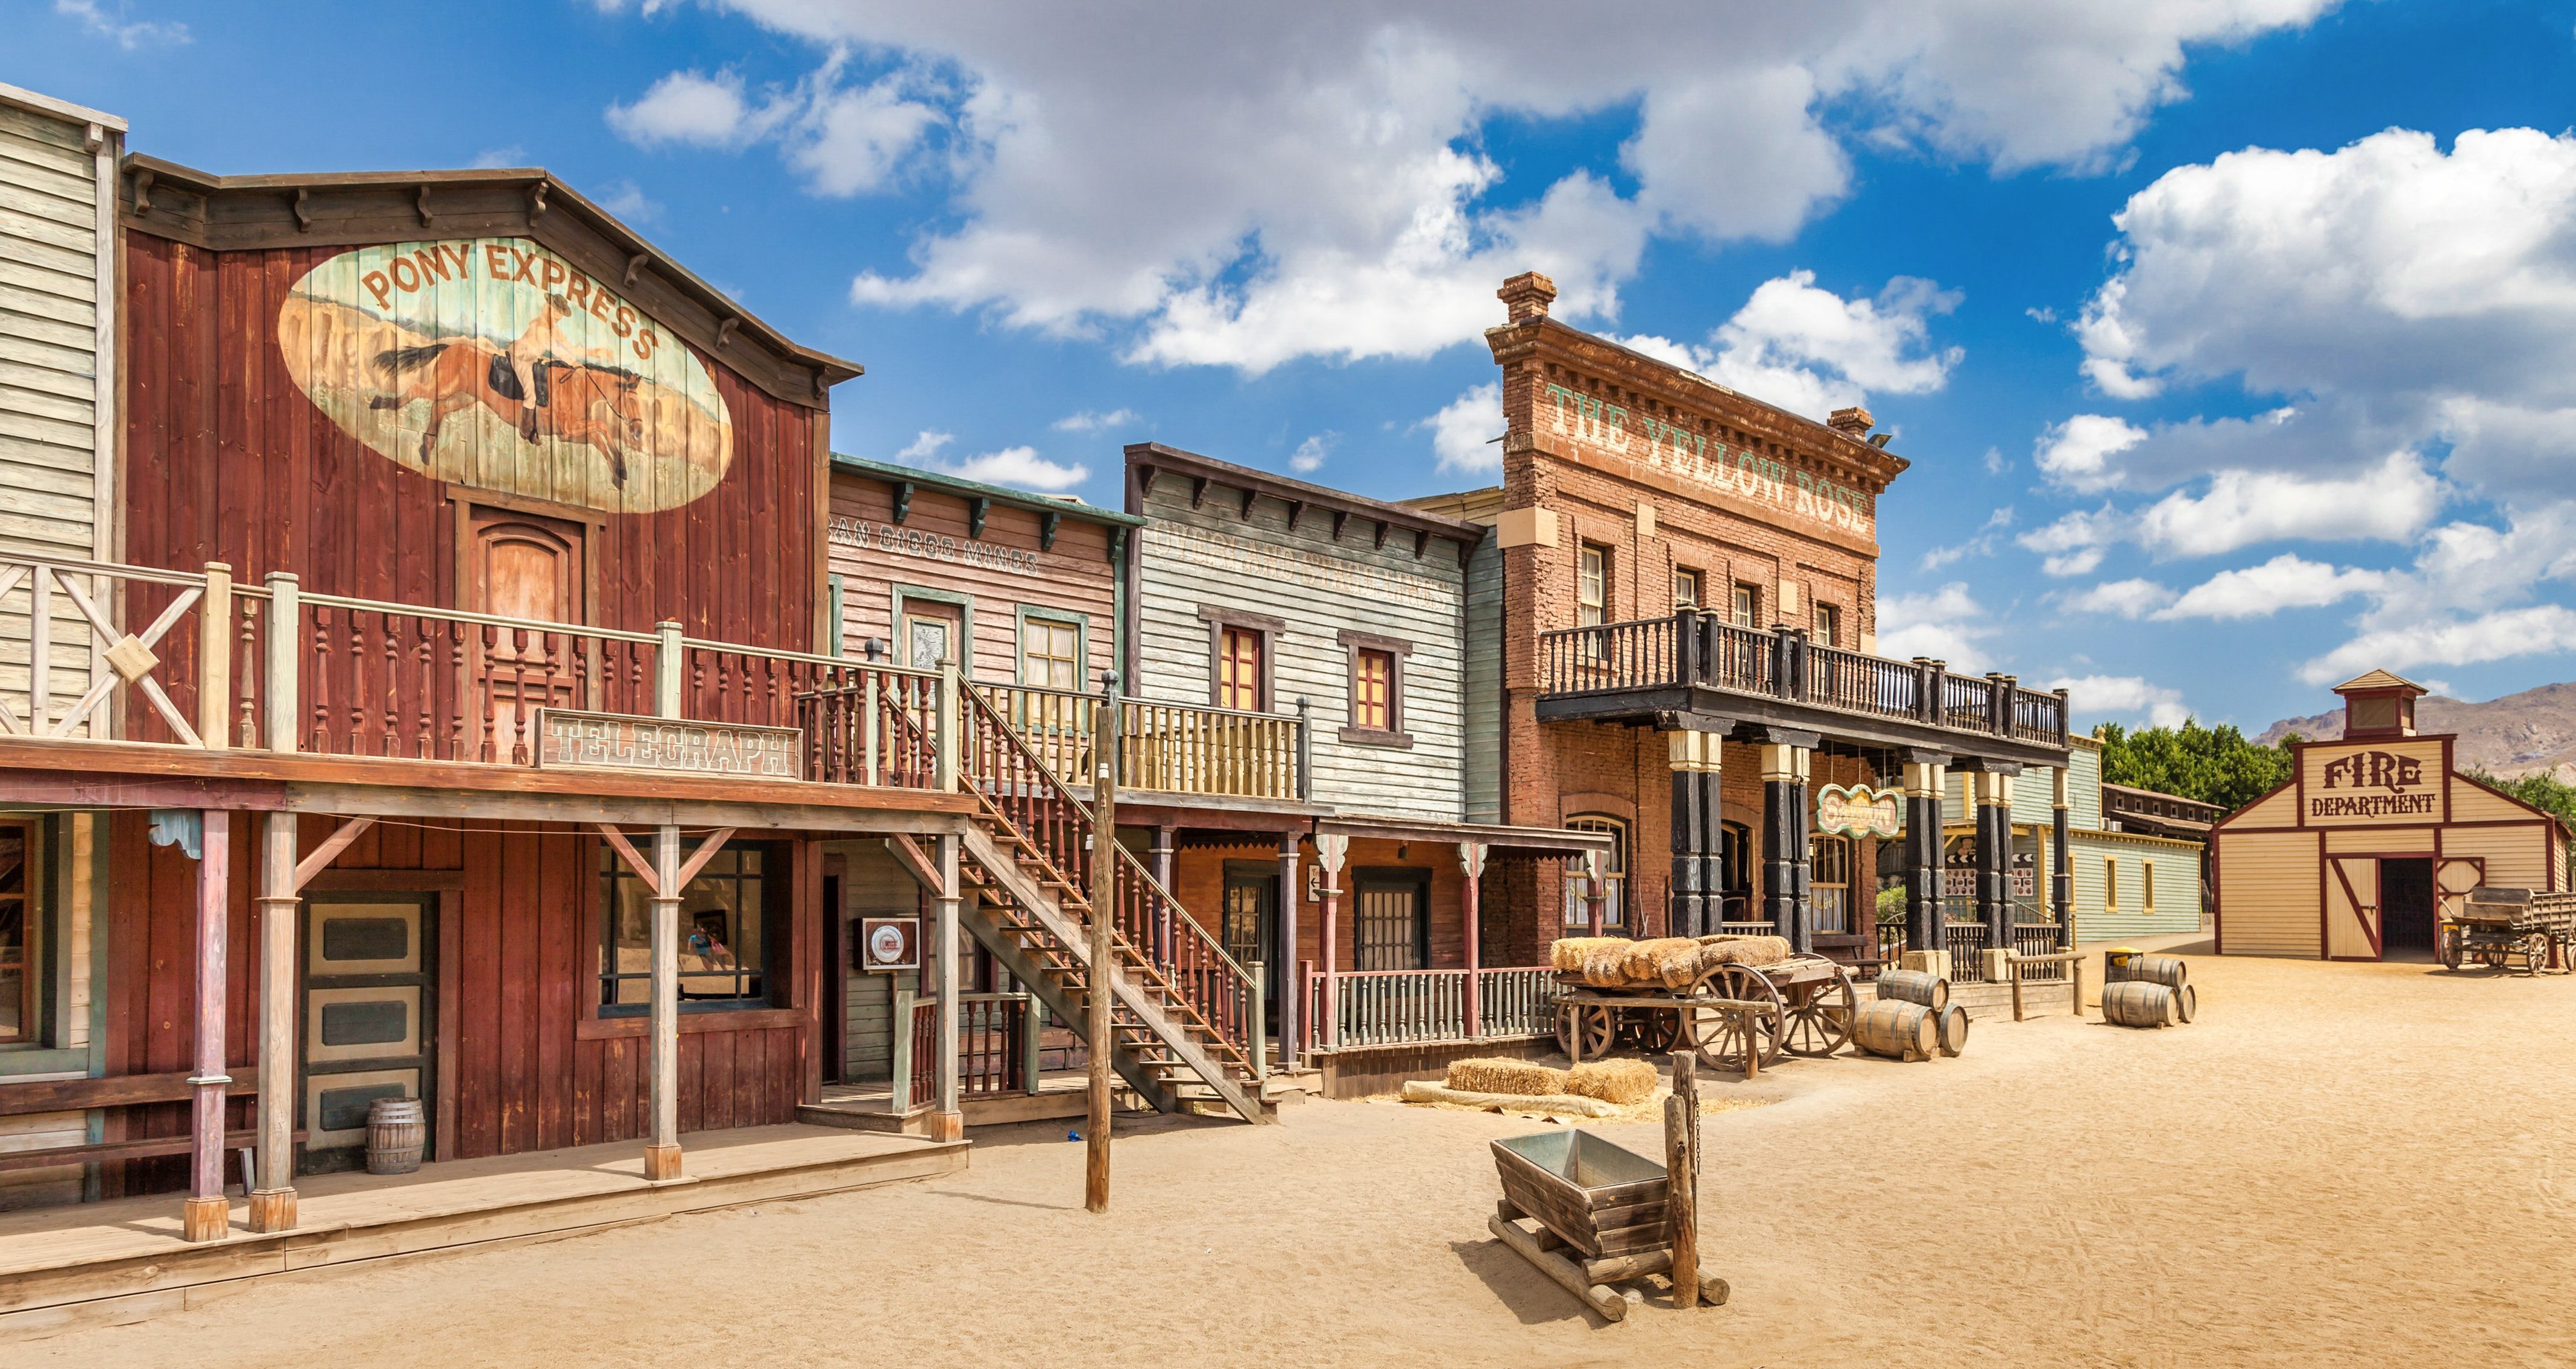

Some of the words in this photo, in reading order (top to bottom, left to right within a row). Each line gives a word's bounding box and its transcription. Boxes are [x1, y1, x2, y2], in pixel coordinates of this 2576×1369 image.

[362, 244, 470, 310] PONY
[487, 245, 659, 359] EXPRESS
[1545, 383, 1629, 453] THE
[1644, 416, 1788, 505] YELLOW
[1795, 470, 1869, 533] ROSE
[829, 516, 870, 548] AN
[879, 525, 955, 562] DIEGO
[964, 540, 1038, 576] MINES
[1154, 519, 1295, 581] OVERLAND
[1302, 551, 1375, 597] STAGE
[552, 717, 789, 776] TELEGRAPH
[2323, 751, 2422, 793] FIRE
[1825, 794, 1892, 826] SALOON
[2311, 793, 2436, 818] DEPARTMENT
